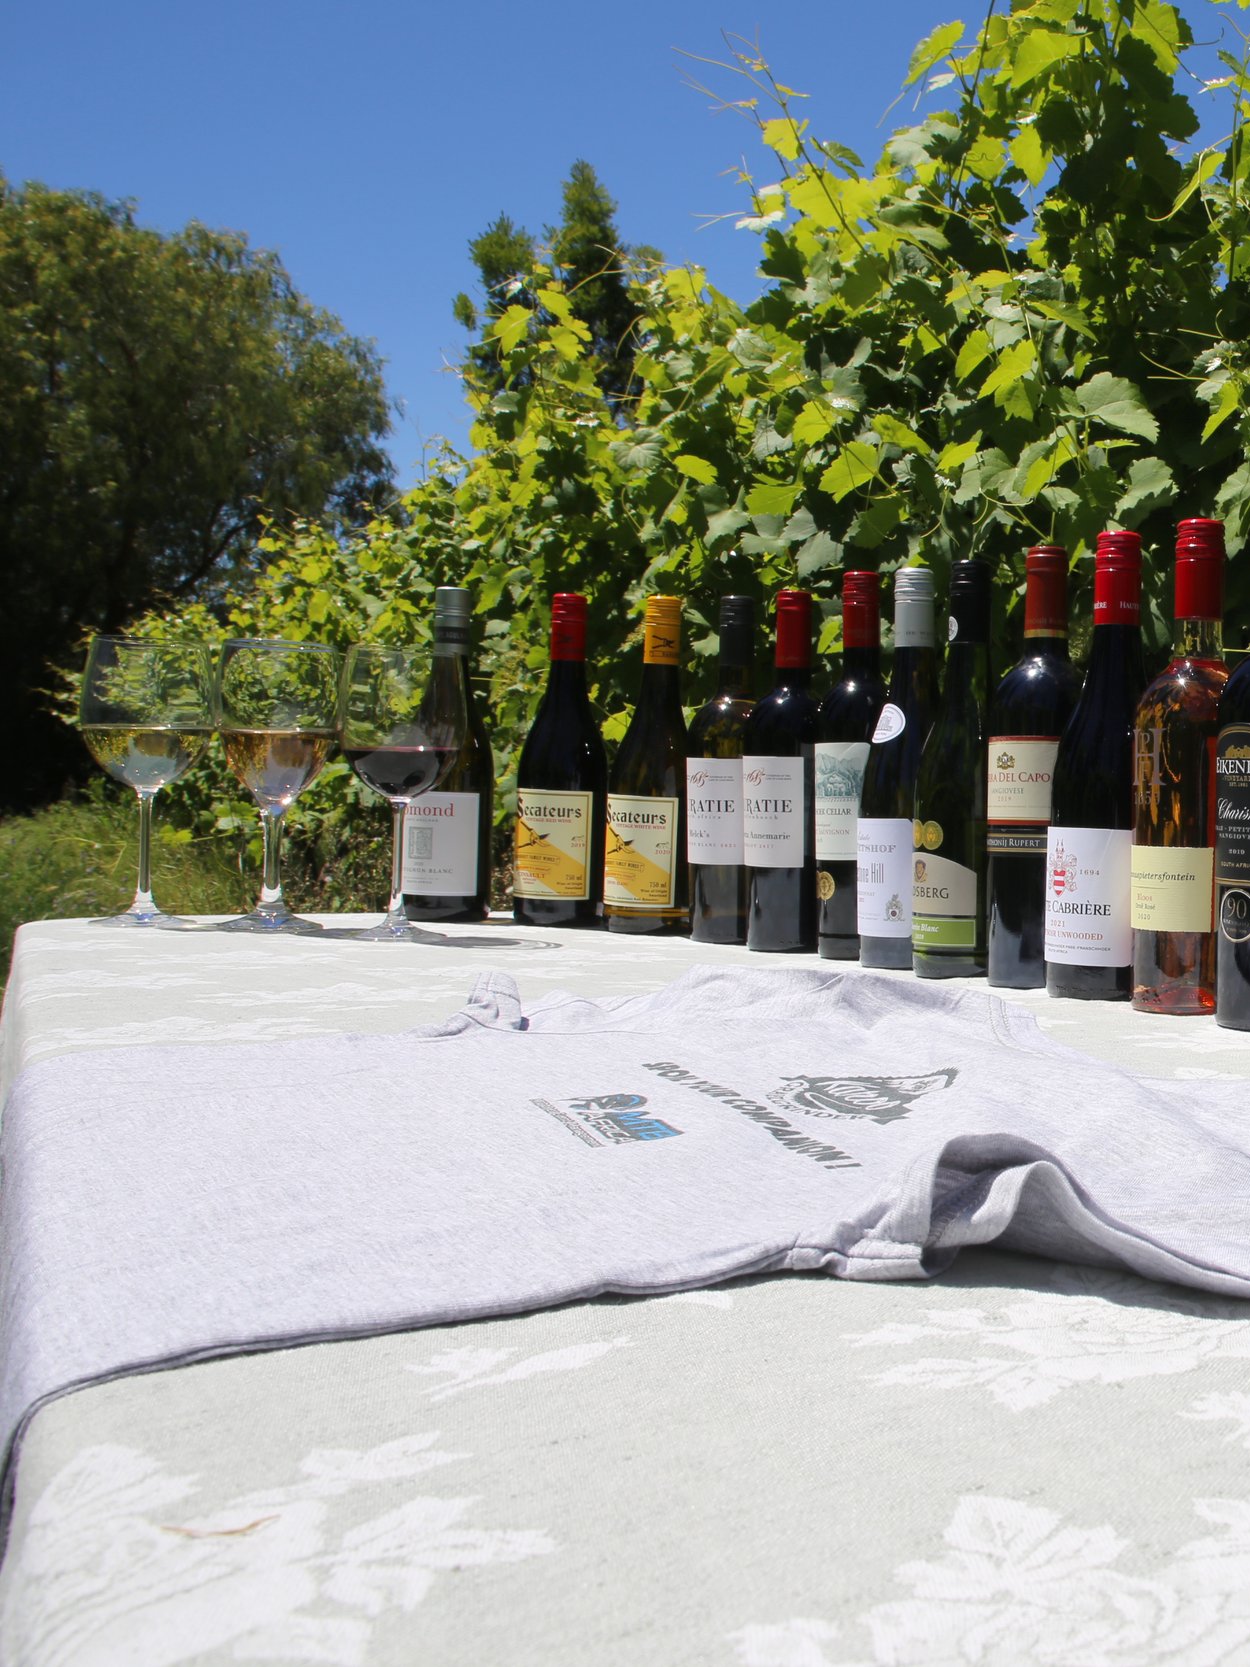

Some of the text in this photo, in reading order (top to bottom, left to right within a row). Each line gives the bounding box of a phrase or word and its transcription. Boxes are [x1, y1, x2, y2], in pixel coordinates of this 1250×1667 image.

[999, 771, 1051, 783] DEL CAPO
[690, 799, 735, 815] RATIE
[746, 799, 793, 815] RATIE
[1009, 838, 1040, 847] RUPERT
[871, 862, 884, 884] Hill
[1052, 900, 1112, 916] CABRIÈRE
[1227, 897, 1247, 919] 90
[920, 923, 939, 933] Blanc
[1050, 919, 1066, 928] 2021
[1057, 931, 1104, 941] UNWOODED
